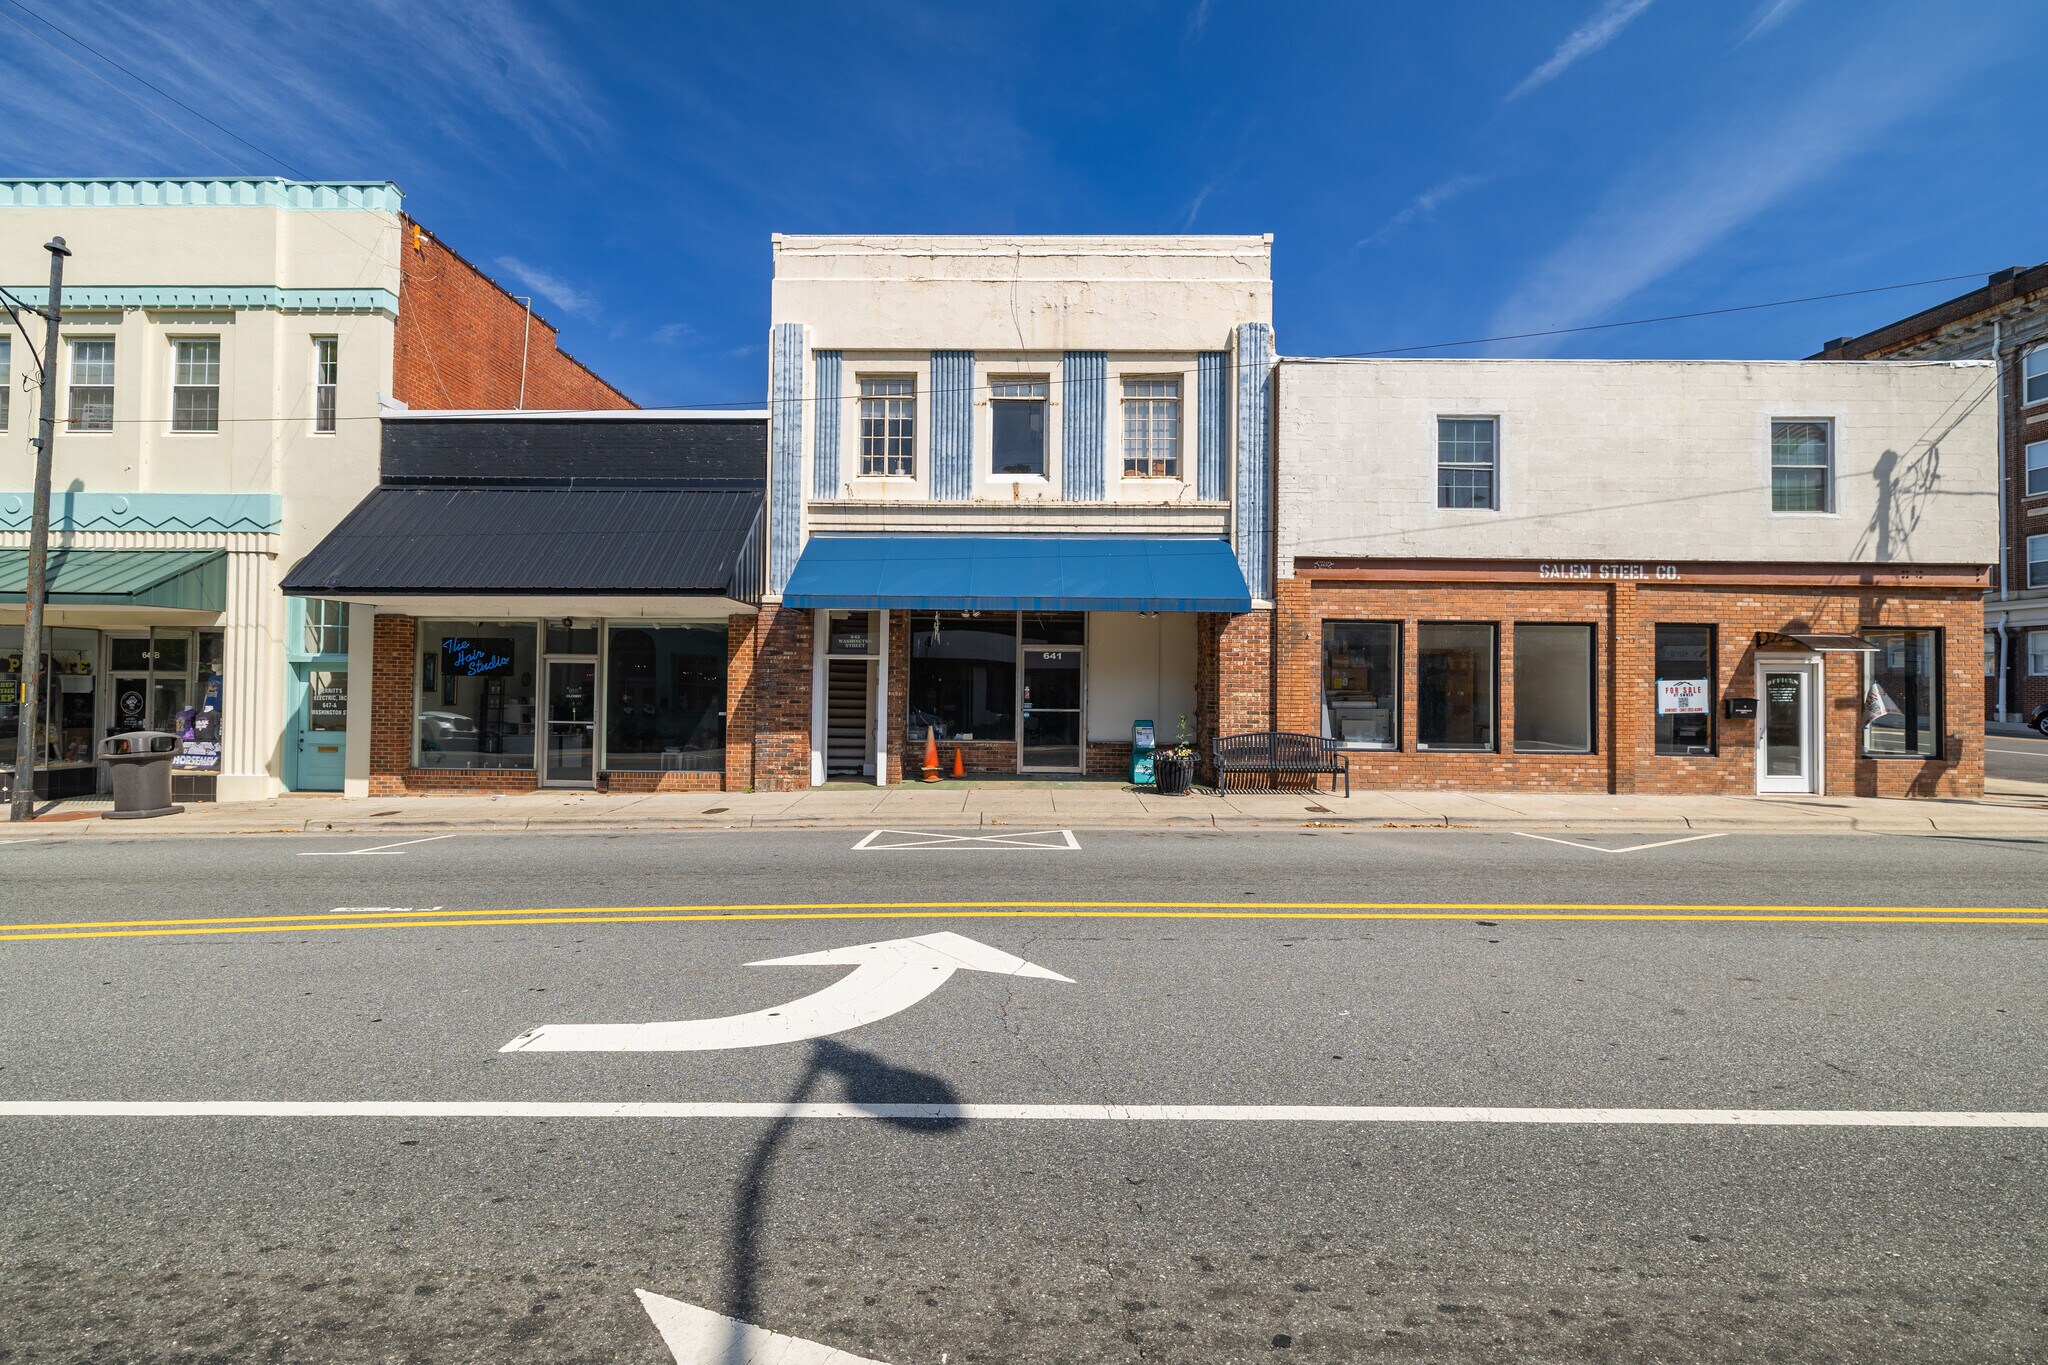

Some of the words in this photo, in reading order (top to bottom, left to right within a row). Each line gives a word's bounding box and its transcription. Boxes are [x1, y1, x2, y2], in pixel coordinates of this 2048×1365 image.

[1539, 564, 1591, 579] SALEM
[1600, 564, 1649, 580] STEEL
[1656, 565, 1681, 580] CO.
[443, 637, 469, 653] The
[142, 651, 160, 659] 64-B
[455, 649, 485, 666] Hair
[1043, 652, 1062, 660] 641
[467, 655, 509, 676] Studio
